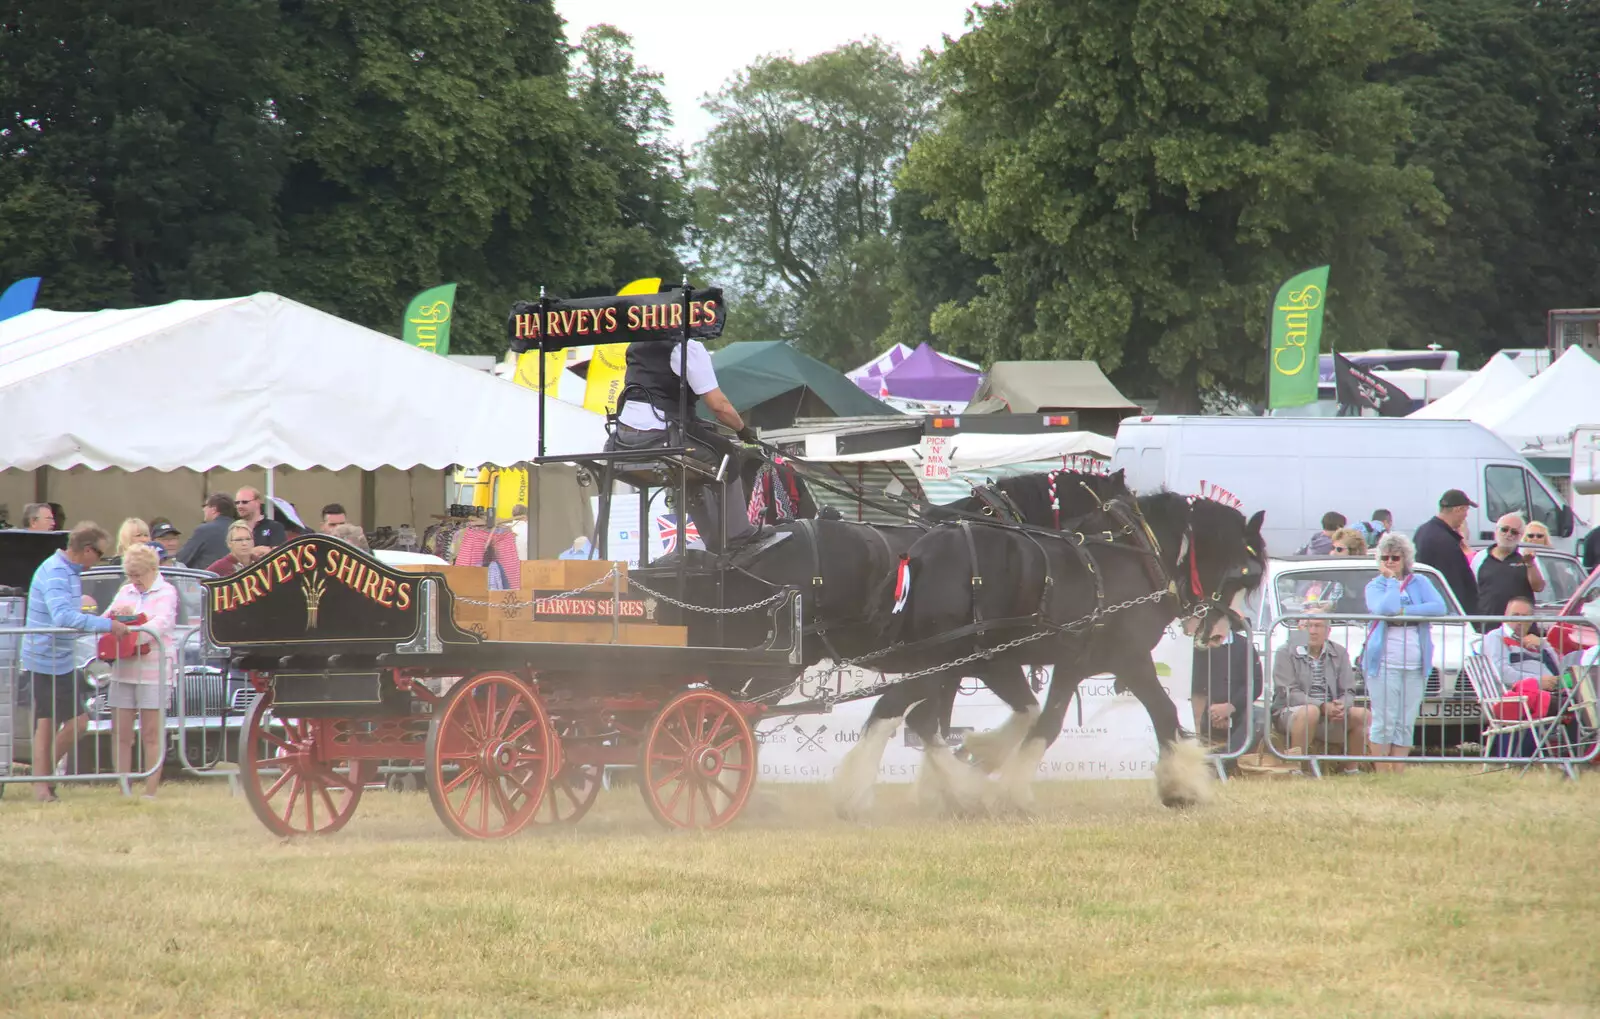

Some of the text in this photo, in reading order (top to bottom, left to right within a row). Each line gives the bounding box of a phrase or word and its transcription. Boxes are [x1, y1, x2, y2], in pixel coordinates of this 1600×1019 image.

[408, 300, 450, 354] ants
[515, 300, 718, 340] HARVEYS SHIRES
[1273, 284, 1322, 375] Cants
[607, 379, 620, 404] West
[926, 437, 946, 445] PICK
[928, 455, 943, 464] MIX
[213, 543, 412, 613] HARVEYS SHIRES
[535, 598, 644, 616] HARVEYS SHRES
[1077, 684, 1115, 697] TUCK
[834, 729, 860, 743] dub
[762, 763, 827, 778] DLEIGH,
[1037, 760, 1113, 773] GWORTH,
